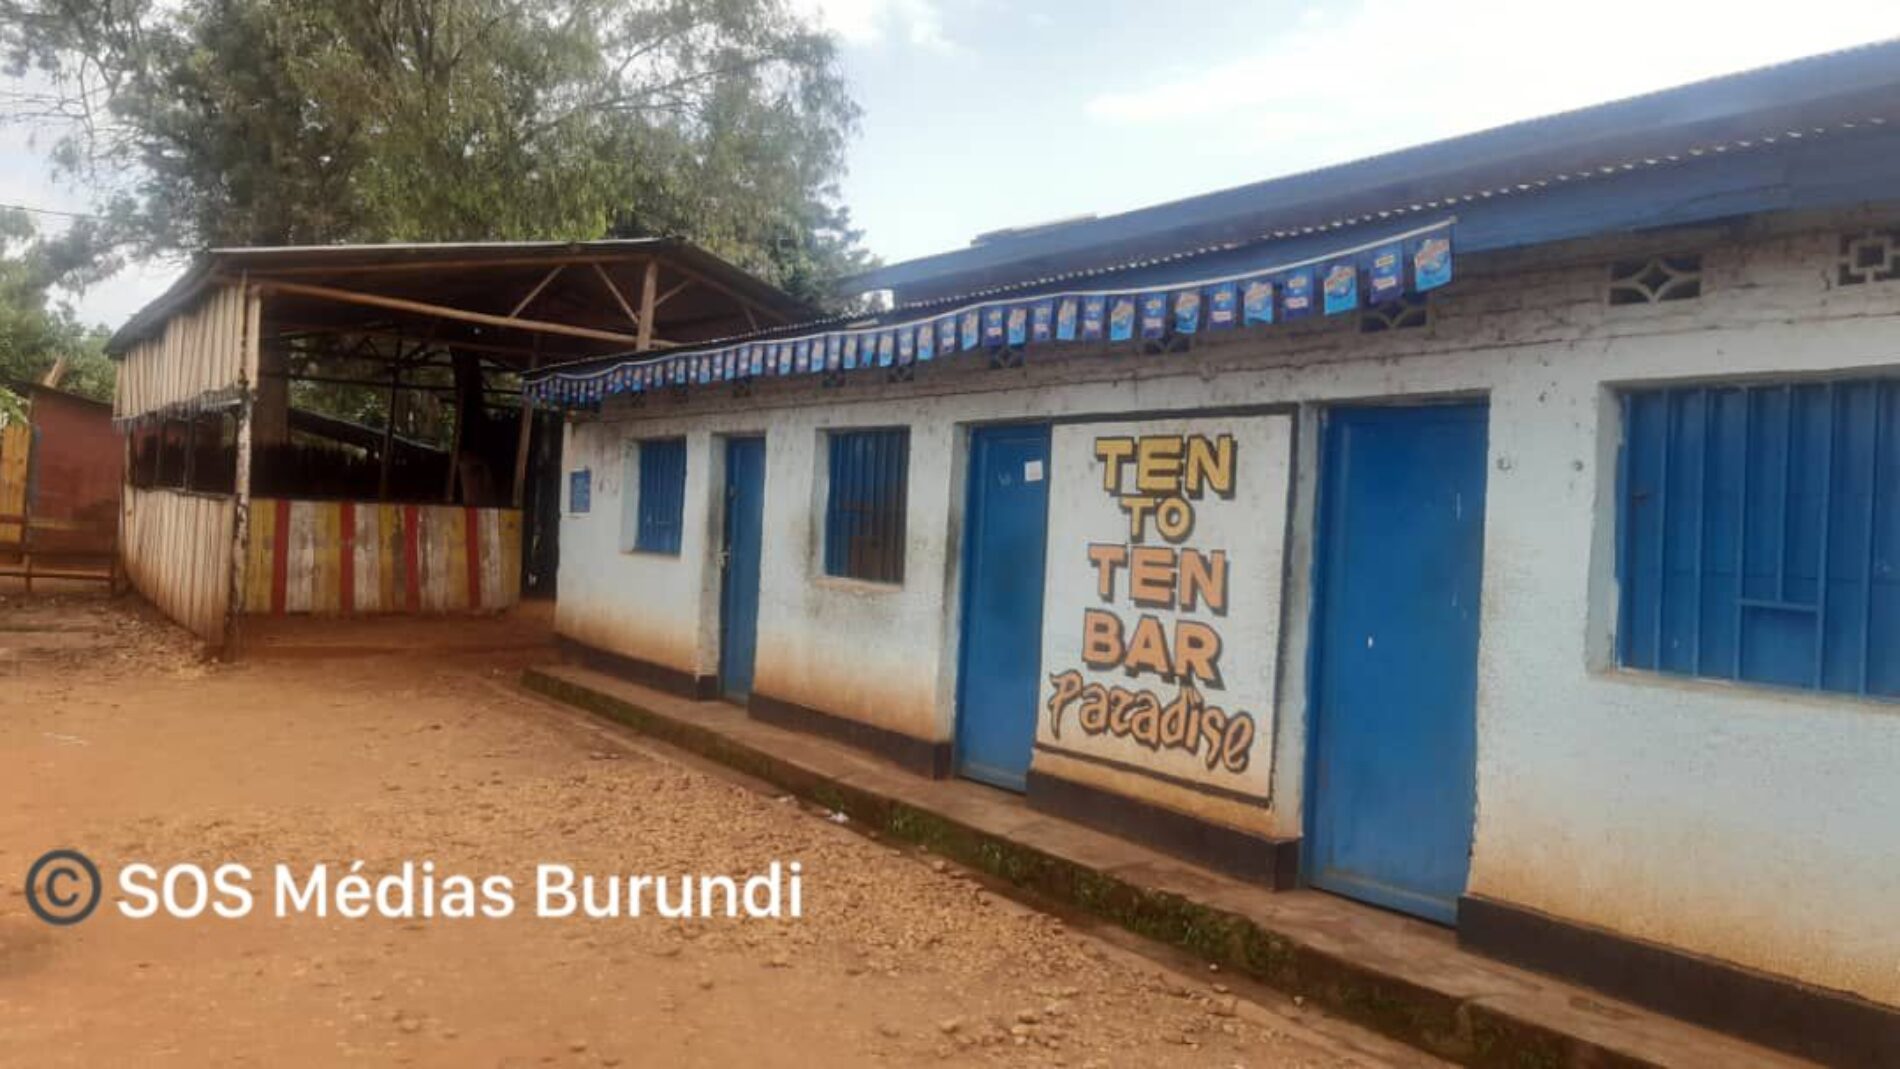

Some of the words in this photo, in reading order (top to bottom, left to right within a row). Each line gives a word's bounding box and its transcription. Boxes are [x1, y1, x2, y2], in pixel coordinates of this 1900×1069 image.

[1095, 433, 1237, 499] TEN
[1119, 493, 1195, 543] TO
[1088, 542, 1230, 616] TEN
[1081, 607, 1226, 690] BAR
[1048, 669, 1255, 774] Paradise
